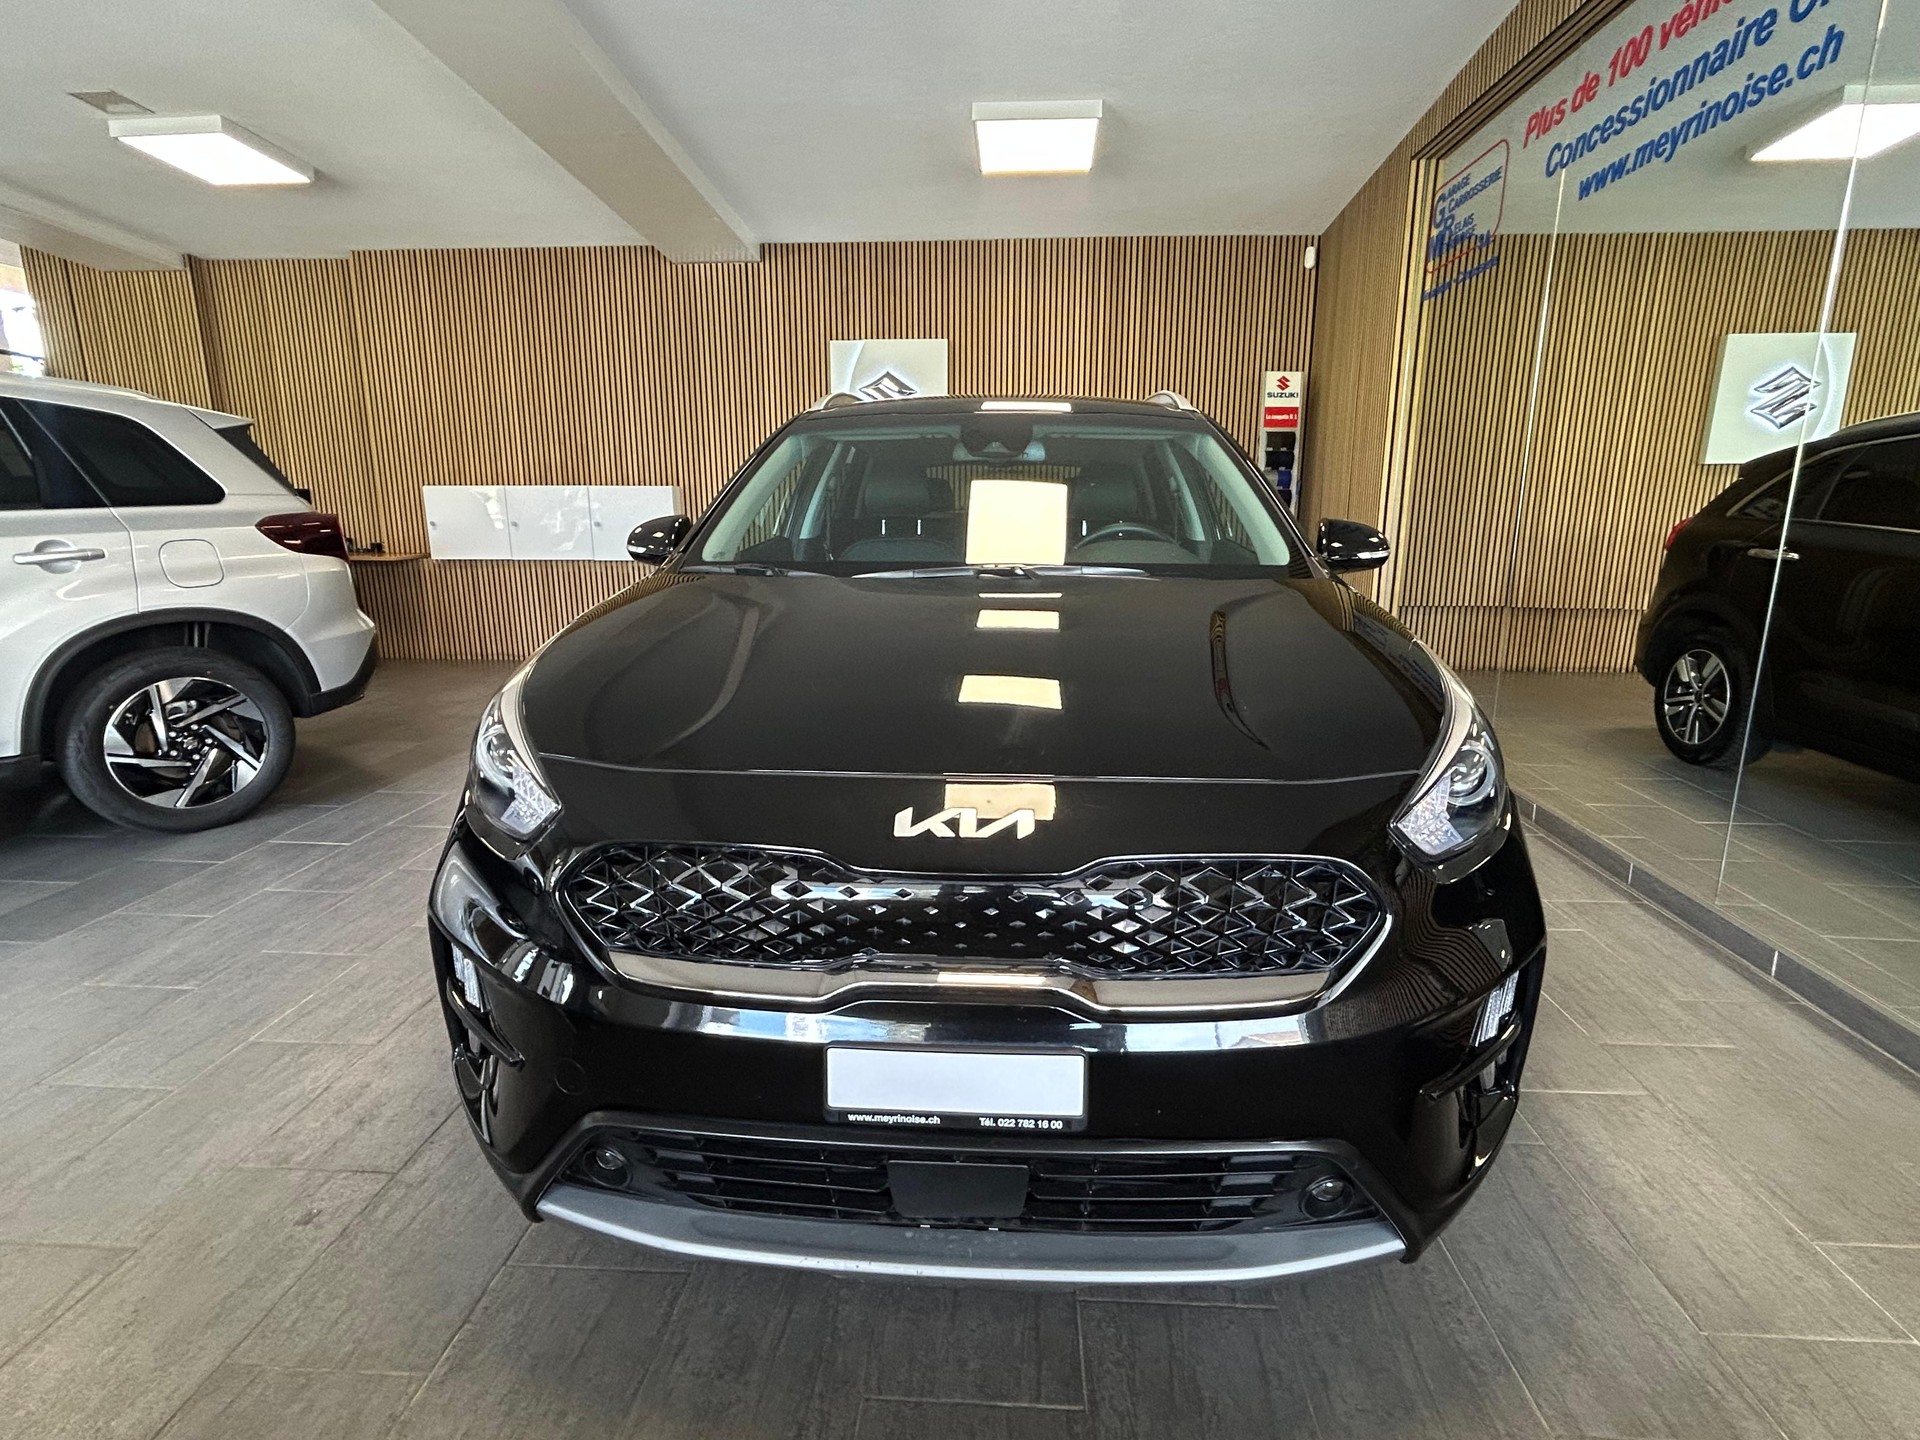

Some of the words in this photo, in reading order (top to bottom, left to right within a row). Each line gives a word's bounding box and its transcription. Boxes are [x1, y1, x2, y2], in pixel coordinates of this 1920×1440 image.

[1523, 98, 1568, 149] Plus
[1571, 70, 1601, 113] de
[1608, 24, 1653, 88] 100
[1660, 0, 1733, 50] véh
[1545, 7, 1778, 178] Concessionnaire
[1578, 24, 1845, 201] www.meyrinoise.ch
[847, 1113, 941, 1125] www.meyrinoise.ch
[979, 1117, 996, 1127] Tél.
[997, 1118, 1016, 1127] 022
[1017, 1119, 1035, 1129] 782
[1050, 1120, 1063, 1130] 00
